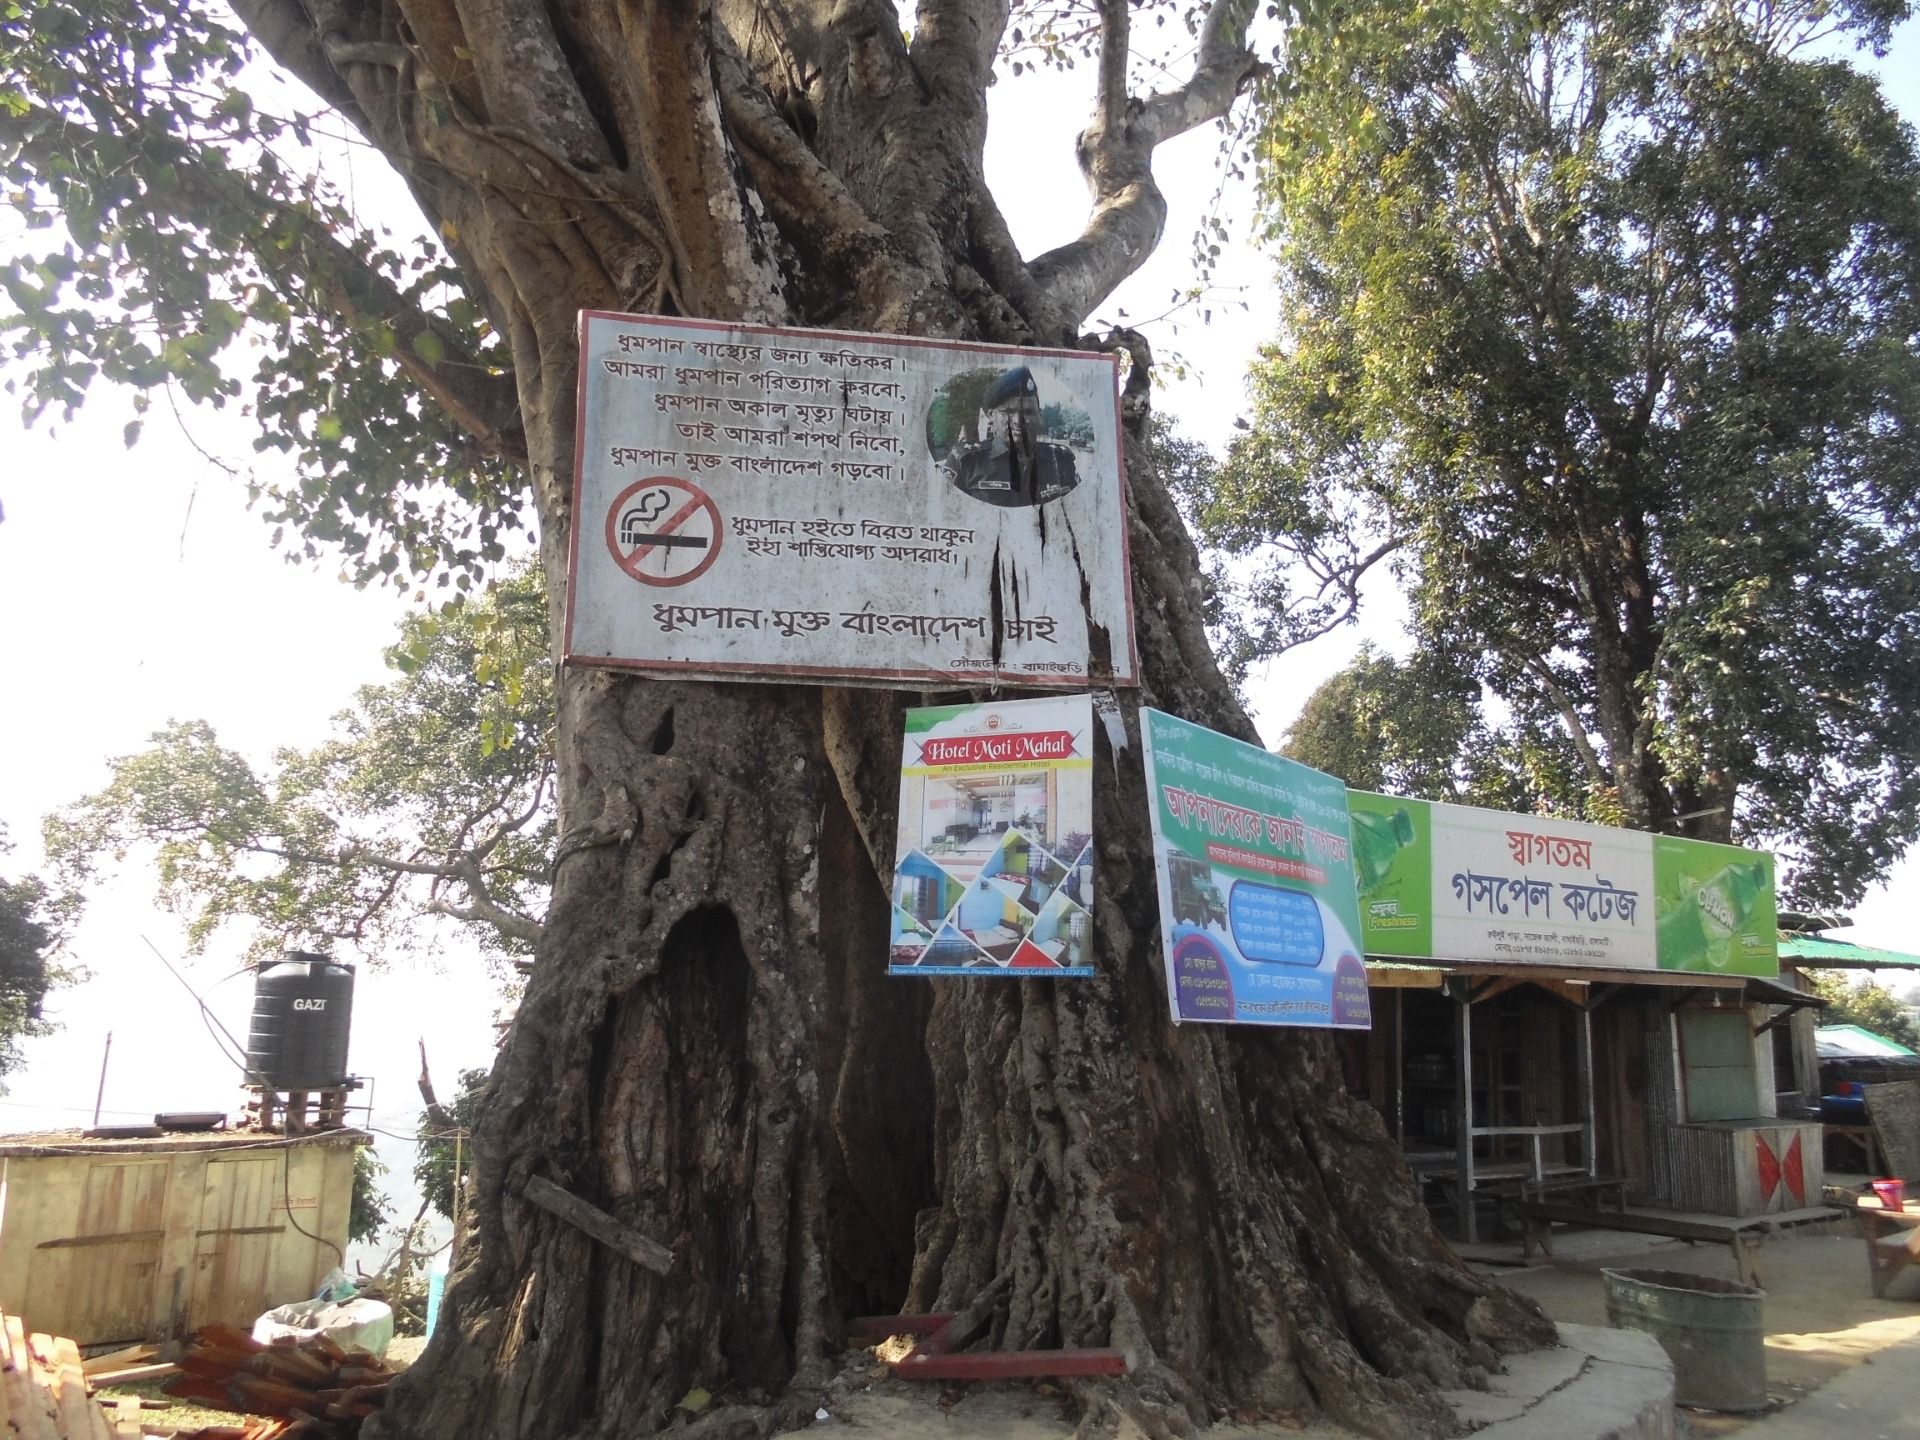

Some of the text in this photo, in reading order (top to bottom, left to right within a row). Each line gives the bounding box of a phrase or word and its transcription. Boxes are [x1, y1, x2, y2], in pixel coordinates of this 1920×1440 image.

[618, 334, 685, 355] ধুমপান
[770, 347, 809, 367] জন্য
[819, 349, 895, 373] ক্ষতিকর
[604, 360, 907, 402] আমরা ধুমপান পরিত্যাগ করবো,
[654, 393, 722, 414] ধুমপান
[727, 398, 787, 419] অকাল
[794, 403, 834, 426] মৃত্যু
[844, 405, 899, 426] ঘটায়
[676, 422, 716, 441] তাই
[723, 427, 785, 447] আমরা
[793, 430, 841, 450] শপথ
[610, 446, 678, 467] ধুমপান
[685, 452, 722, 474] মুক্ত
[730, 455, 821, 477] বাংলাদেশ
[830, 461, 891, 482] গড়বো
[731, 516, 975, 548] ধুমপান হইতে বিরত থাকুন
[746, 537, 781, 557] ইহা
[787, 539, 875, 561] শাস্তিযোগ্য
[652, 603, 1058, 643] ধুমপান মুক্ত বাংলাদেশ চাই
[928, 735, 1066, 760] Hotel Moti Mahal
[954, 762, 987, 772] Exclusive
[988, 761, 1029, 770] Residential
[1030, 759, 1050, 768] Hotel
[1163, 784, 1262, 845] আপনাদেরকে
[1263, 809, 1305, 855] জানাই
[1506, 831, 1591, 869] স্বাগতম
[1452, 868, 1639, 926] গসপেল কটেজ
[294, 999, 327, 1010] GAZI
